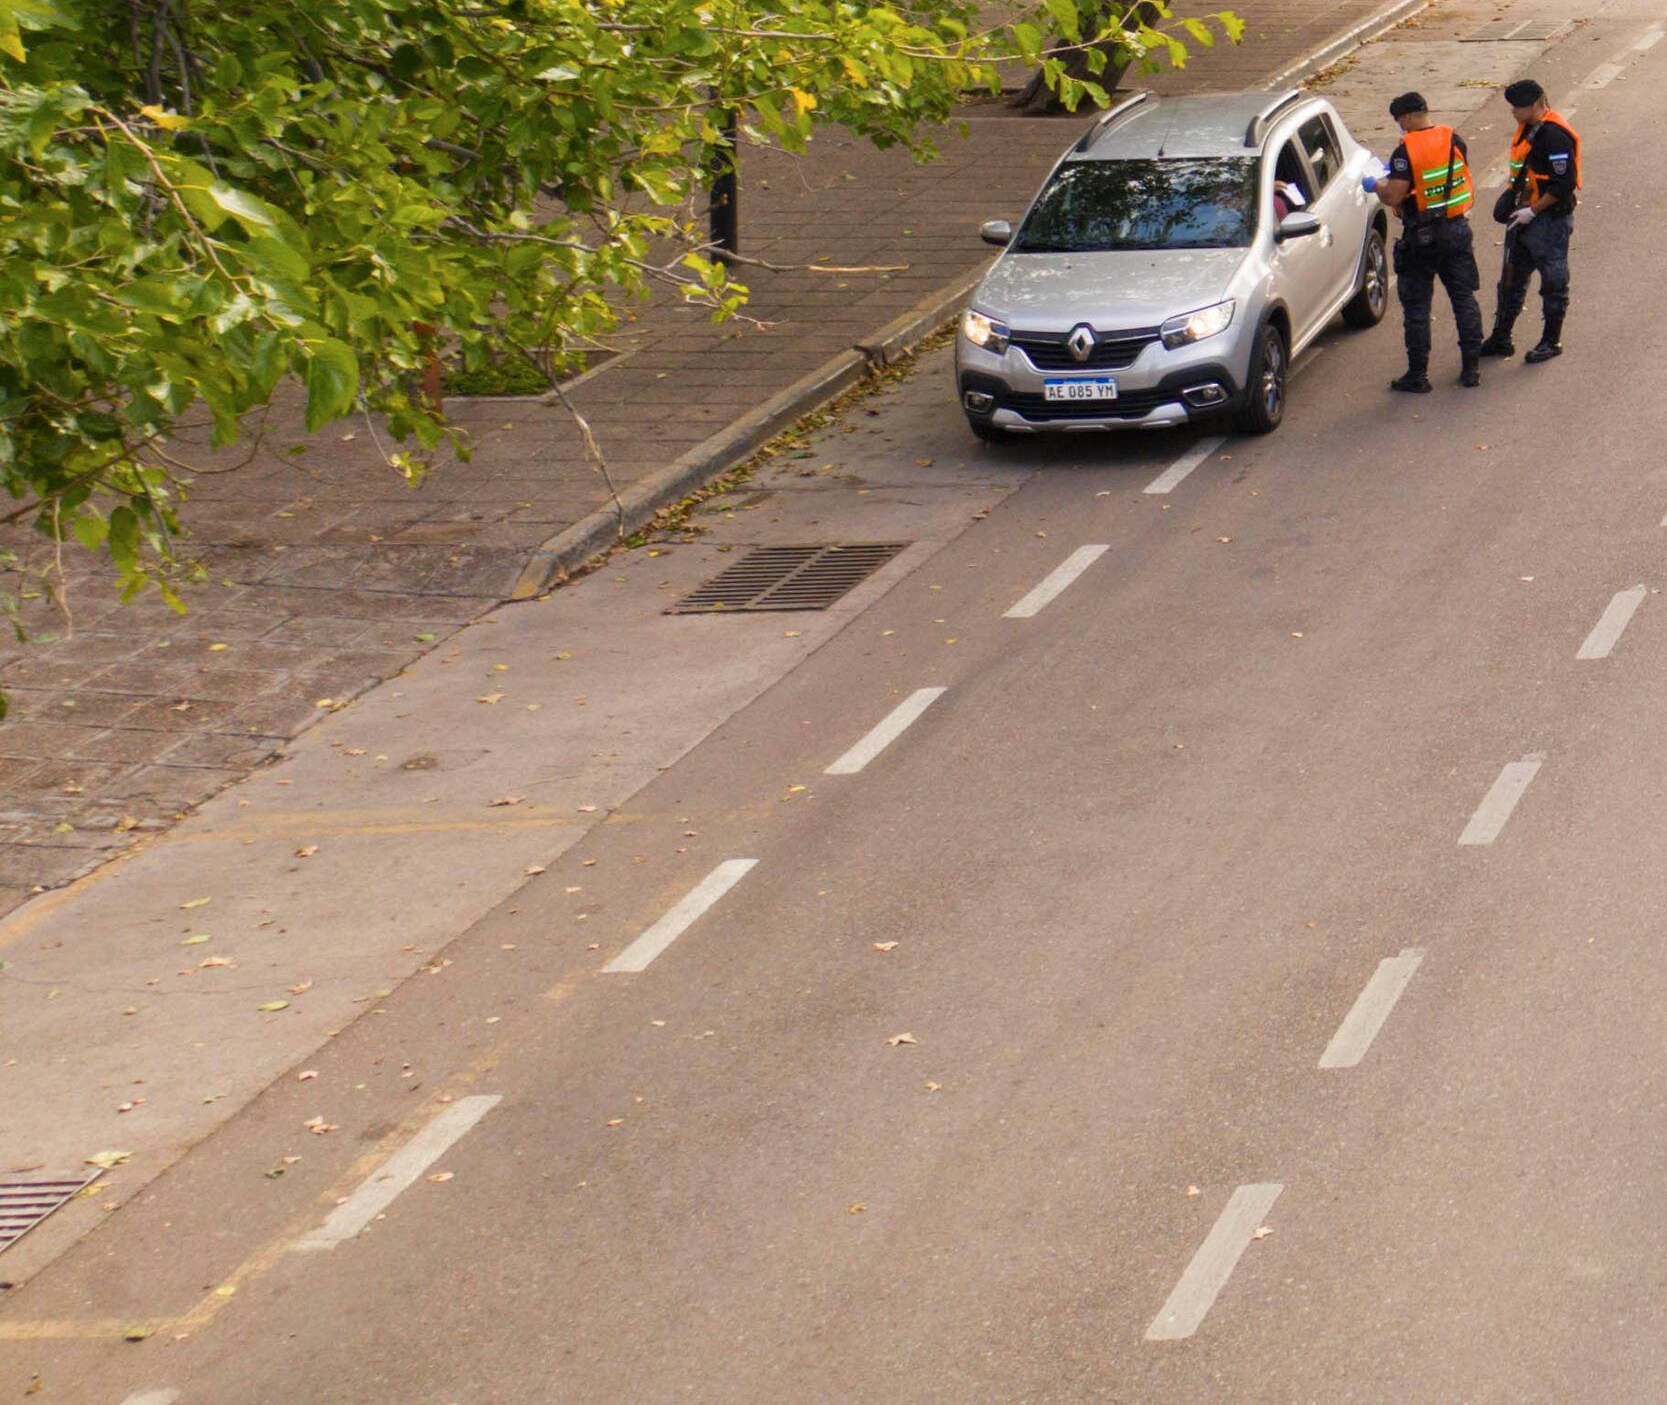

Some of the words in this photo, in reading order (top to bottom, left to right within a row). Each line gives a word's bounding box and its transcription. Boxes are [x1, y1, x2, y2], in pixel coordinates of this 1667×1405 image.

[1048, 386, 1064, 399] AE
[1068, 385, 1093, 398] 085
[1097, 384, 1114, 397] YM
